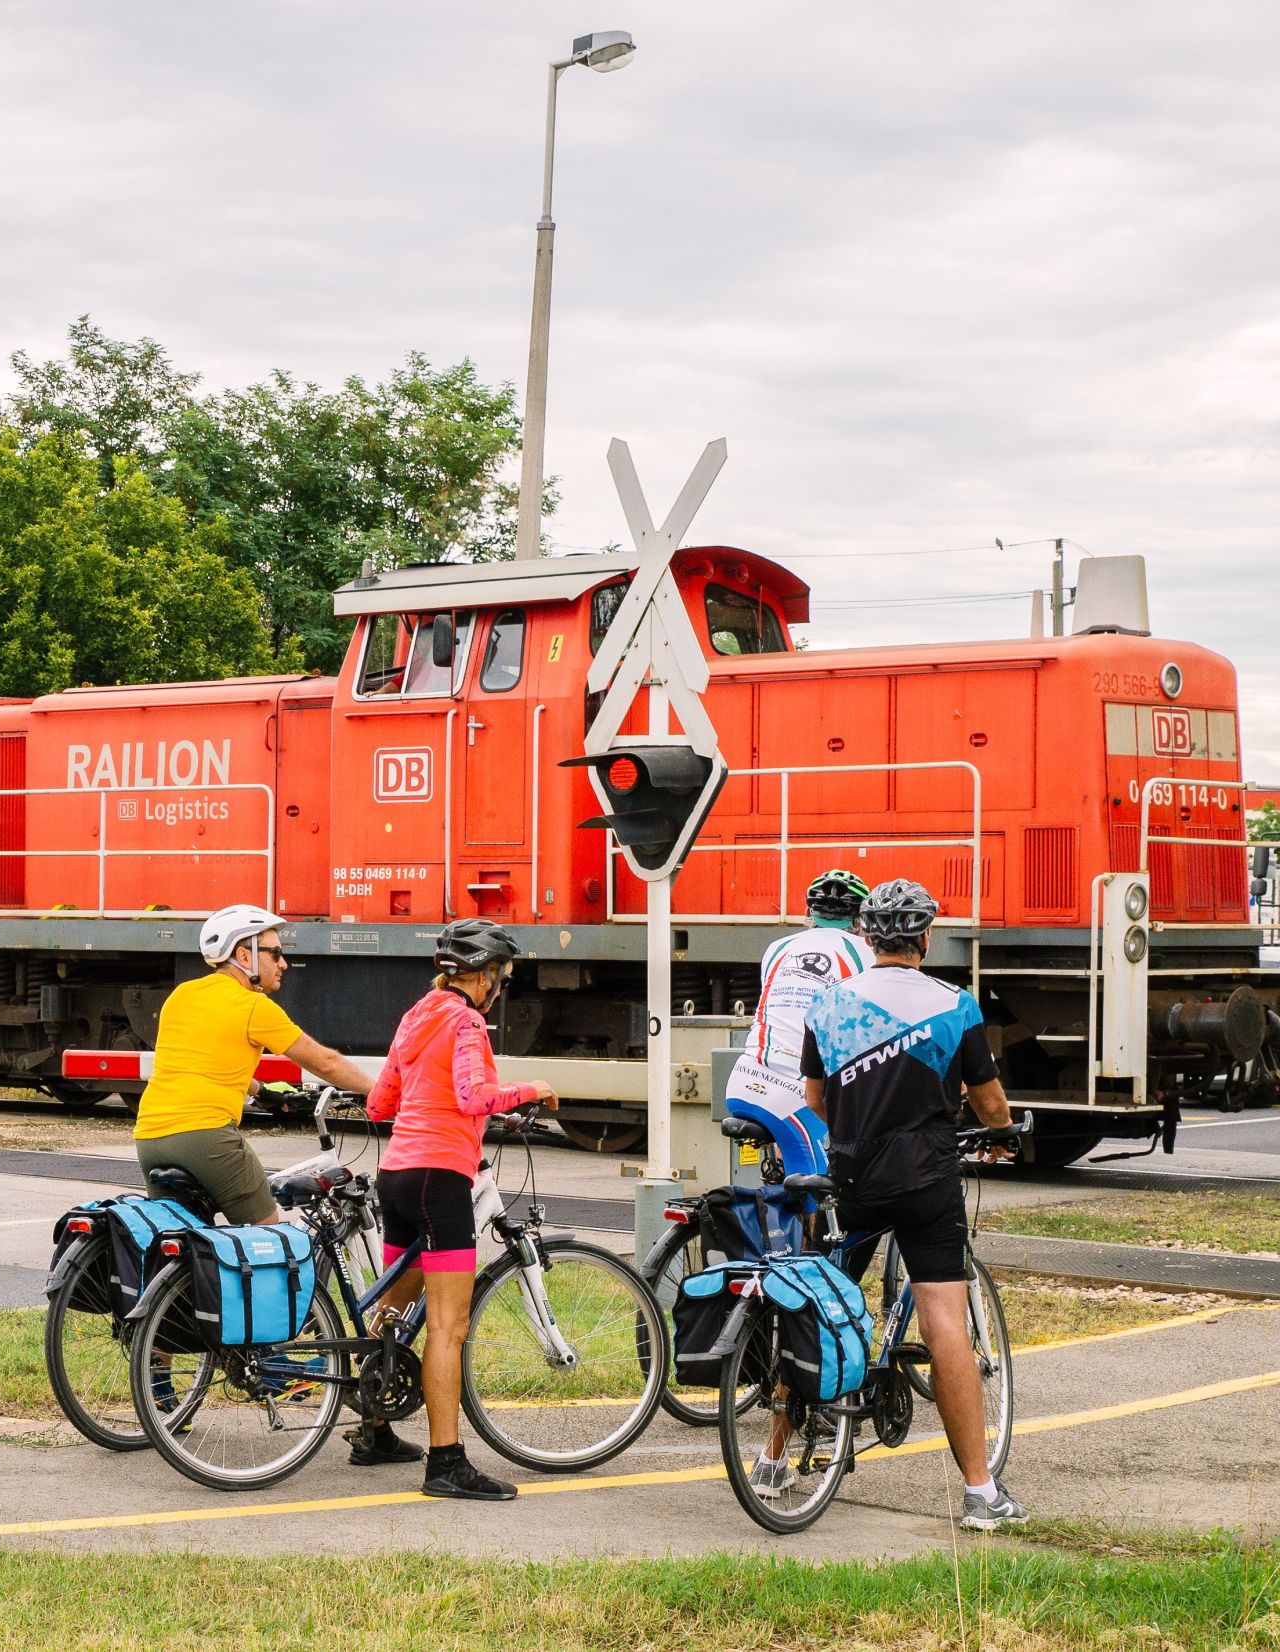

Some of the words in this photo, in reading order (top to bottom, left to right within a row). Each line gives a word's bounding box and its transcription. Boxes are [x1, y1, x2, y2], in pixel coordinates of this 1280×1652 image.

[1093, 671, 1119, 694] 290
[1156, 715, 1188, 750] DB
[66, 738, 232, 789] RAILION
[379, 753, 428, 796] DB
[1128, 779, 1173, 806] 069
[1178, 784, 1228, 810] 114-0
[120, 802, 137, 818] DB
[145, 796, 229, 826] Logistics
[333, 867, 348, 880] 98
[349, 867, 364, 880] 55
[365, 867, 393, 880] 0469
[395, 867, 427, 880] 114-0
[336, 883, 373, 897] H-DBH
[840, 1023, 933, 1087] B'TWIN
[751, 1069, 798, 1093] BUNKERAGGI
[333, 1242, 351, 1285] SCHAUFF
